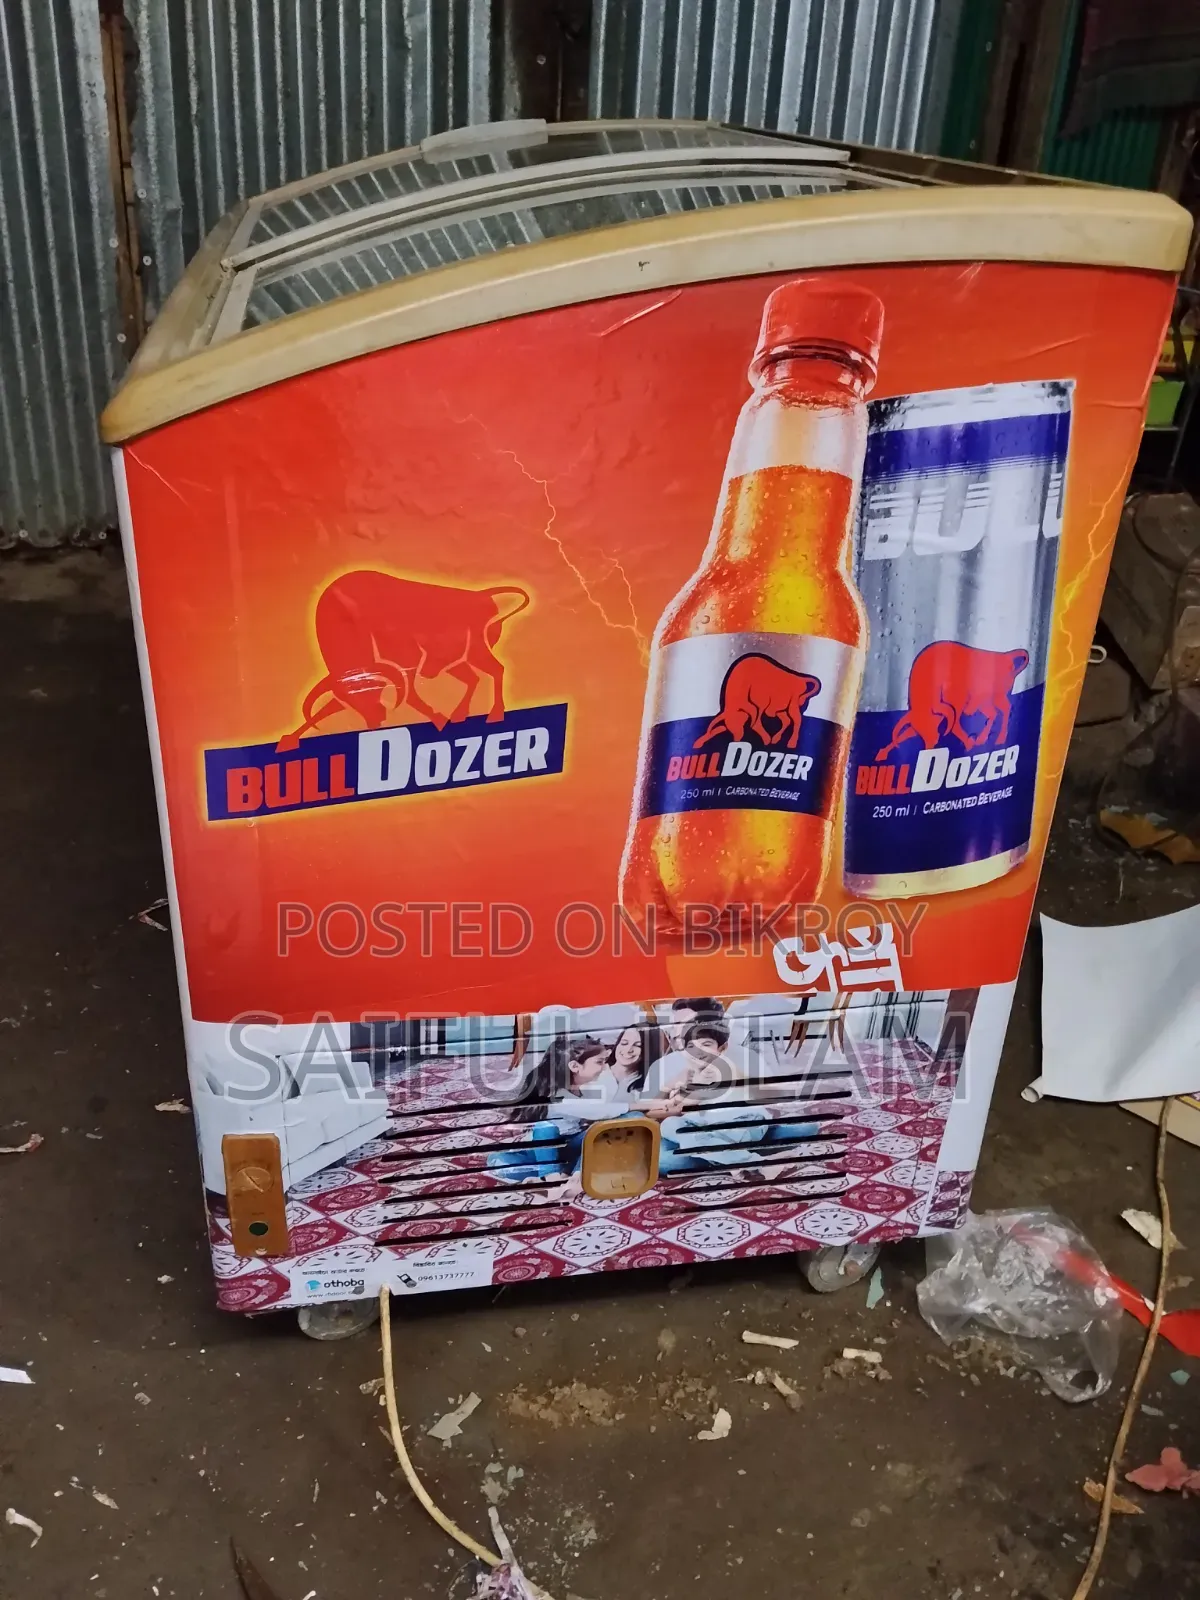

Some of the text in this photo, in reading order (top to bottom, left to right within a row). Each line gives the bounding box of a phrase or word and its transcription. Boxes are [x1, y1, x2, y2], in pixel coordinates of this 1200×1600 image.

[226, 726, 550, 814] BULLDOZER
[666, 741, 813, 782] BULLDOZER
[855, 744, 1020, 796] BULLDOZER
[680, 788, 699, 800] 250
[702, 786, 715, 798] ml
[872, 785, 1014, 819] 250 ml CARBONATED BEVERAGE
[323, 1278, 365, 1289] othoba
